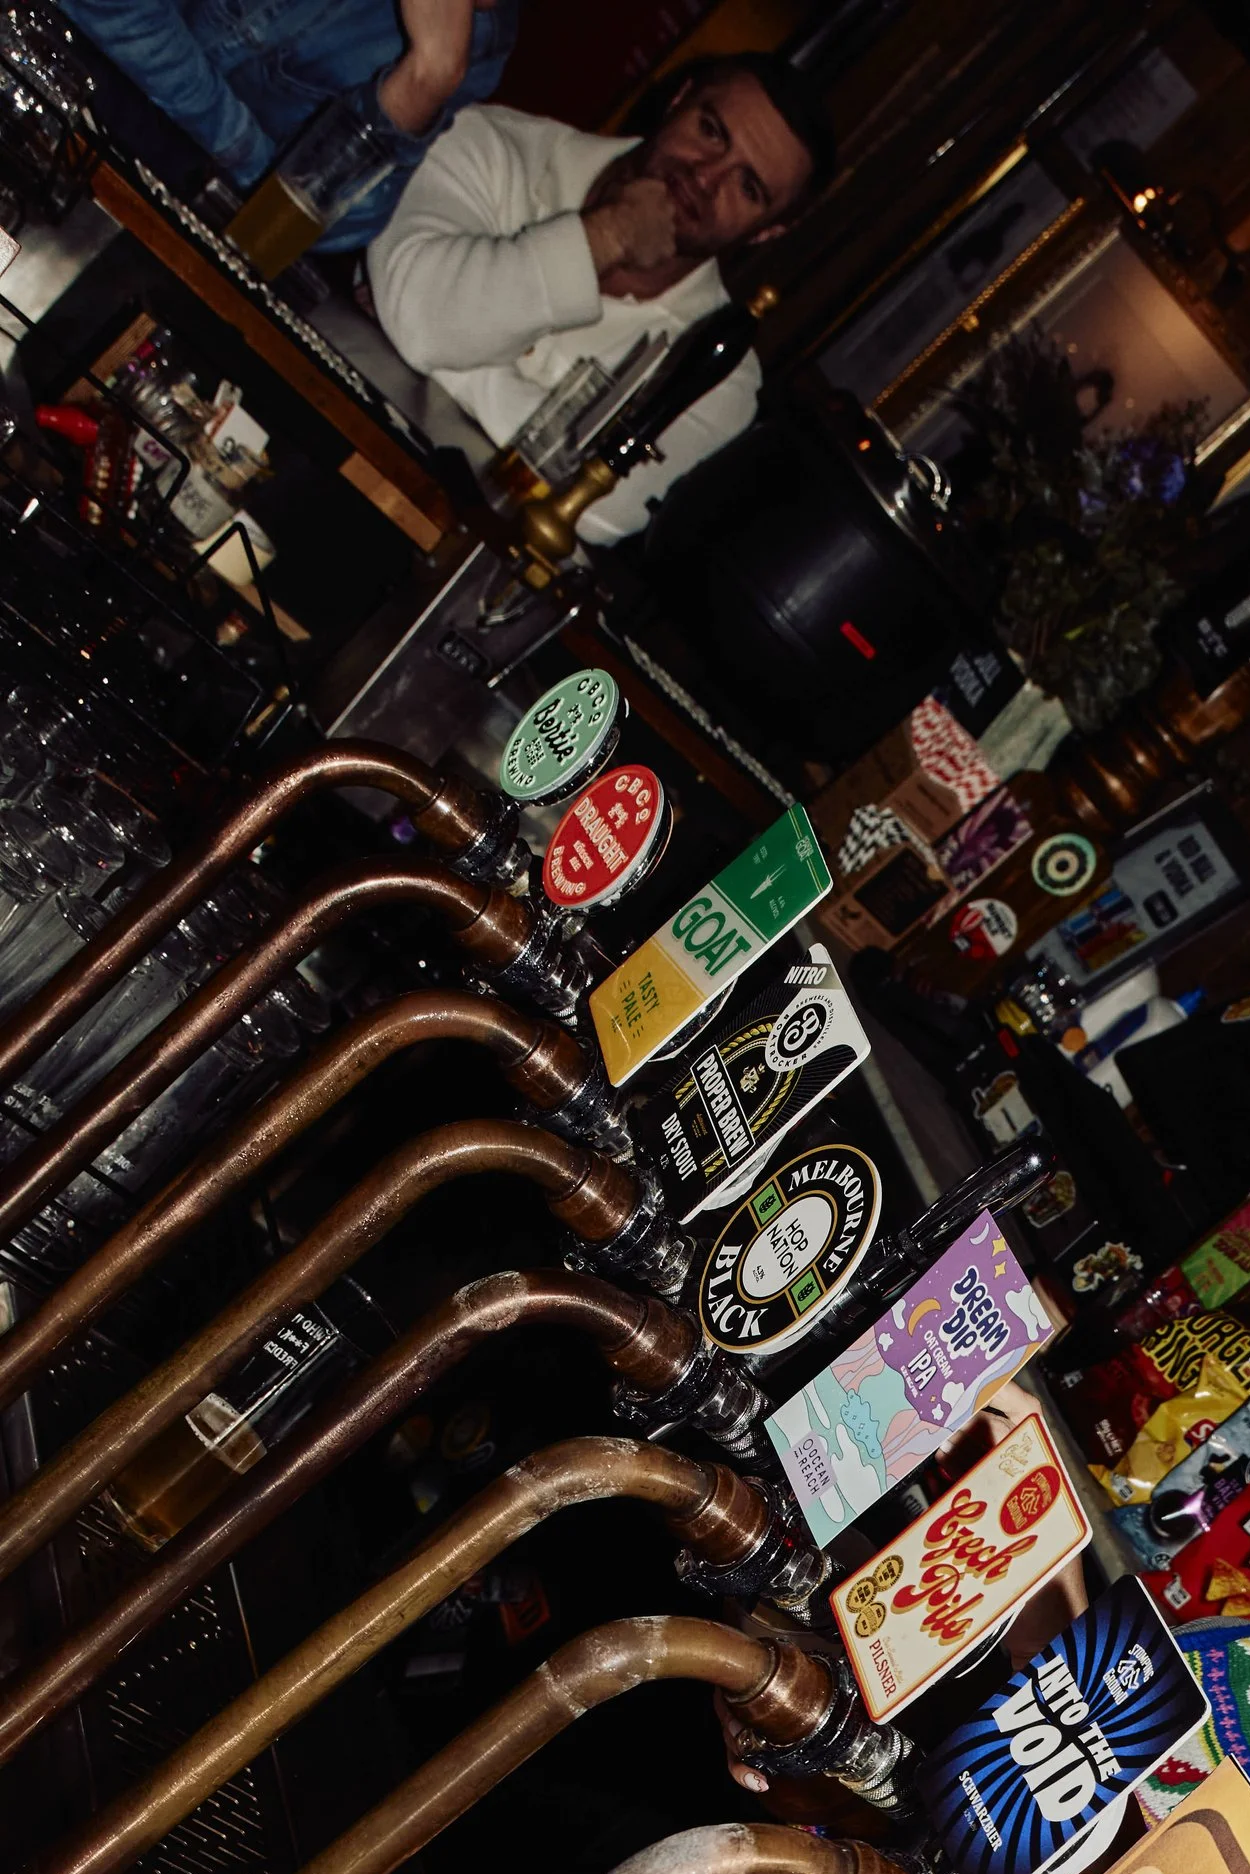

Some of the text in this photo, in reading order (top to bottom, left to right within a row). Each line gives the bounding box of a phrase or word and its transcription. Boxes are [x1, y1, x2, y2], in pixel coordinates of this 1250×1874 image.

[533, 698, 574, 763] Bertie
[508, 739, 533, 785] BREWING
[574, 797, 629, 873] DRAUGHT
[551, 845, 586, 896] BREWING
[672, 897, 752, 976] GOAT
[638, 972, 661, 1014] TASTY
[783, 966, 828, 984] NITRO
[621, 992, 641, 1028] PALE
[769, 1014, 807, 1067] BOATROCKER
[696, 1052, 750, 1158] PROPER BREW
[661, 1112, 698, 1181] DRY STOUT
[785, 1218, 809, 1252] HOP
[788, 1159, 865, 1273] MELBOURNE
[767, 1223, 799, 1279] NATION
[708, 1244, 769, 1339] BLACK
[954, 1268, 1008, 1352] DREAM
[923, 1329, 953, 1379] OAT CREAM
[943, 1312, 977, 1351] DIP
[907, 1349, 938, 1390] IPA
[798, 1458, 820, 1497] REACH
[924, 1488, 1038, 1584] Czech
[890, 1564, 984, 1645] Pils
[868, 1638, 897, 1698] PILSNER
[1102, 1667, 1130, 1706] GROUND
[1128, 1643, 1155, 1684] STOMPING
[1037, 1654, 1122, 1782] INTO THE
[991, 1677, 1097, 1823] VOID
[958, 1770, 1003, 1852] SCHWARZBIER
